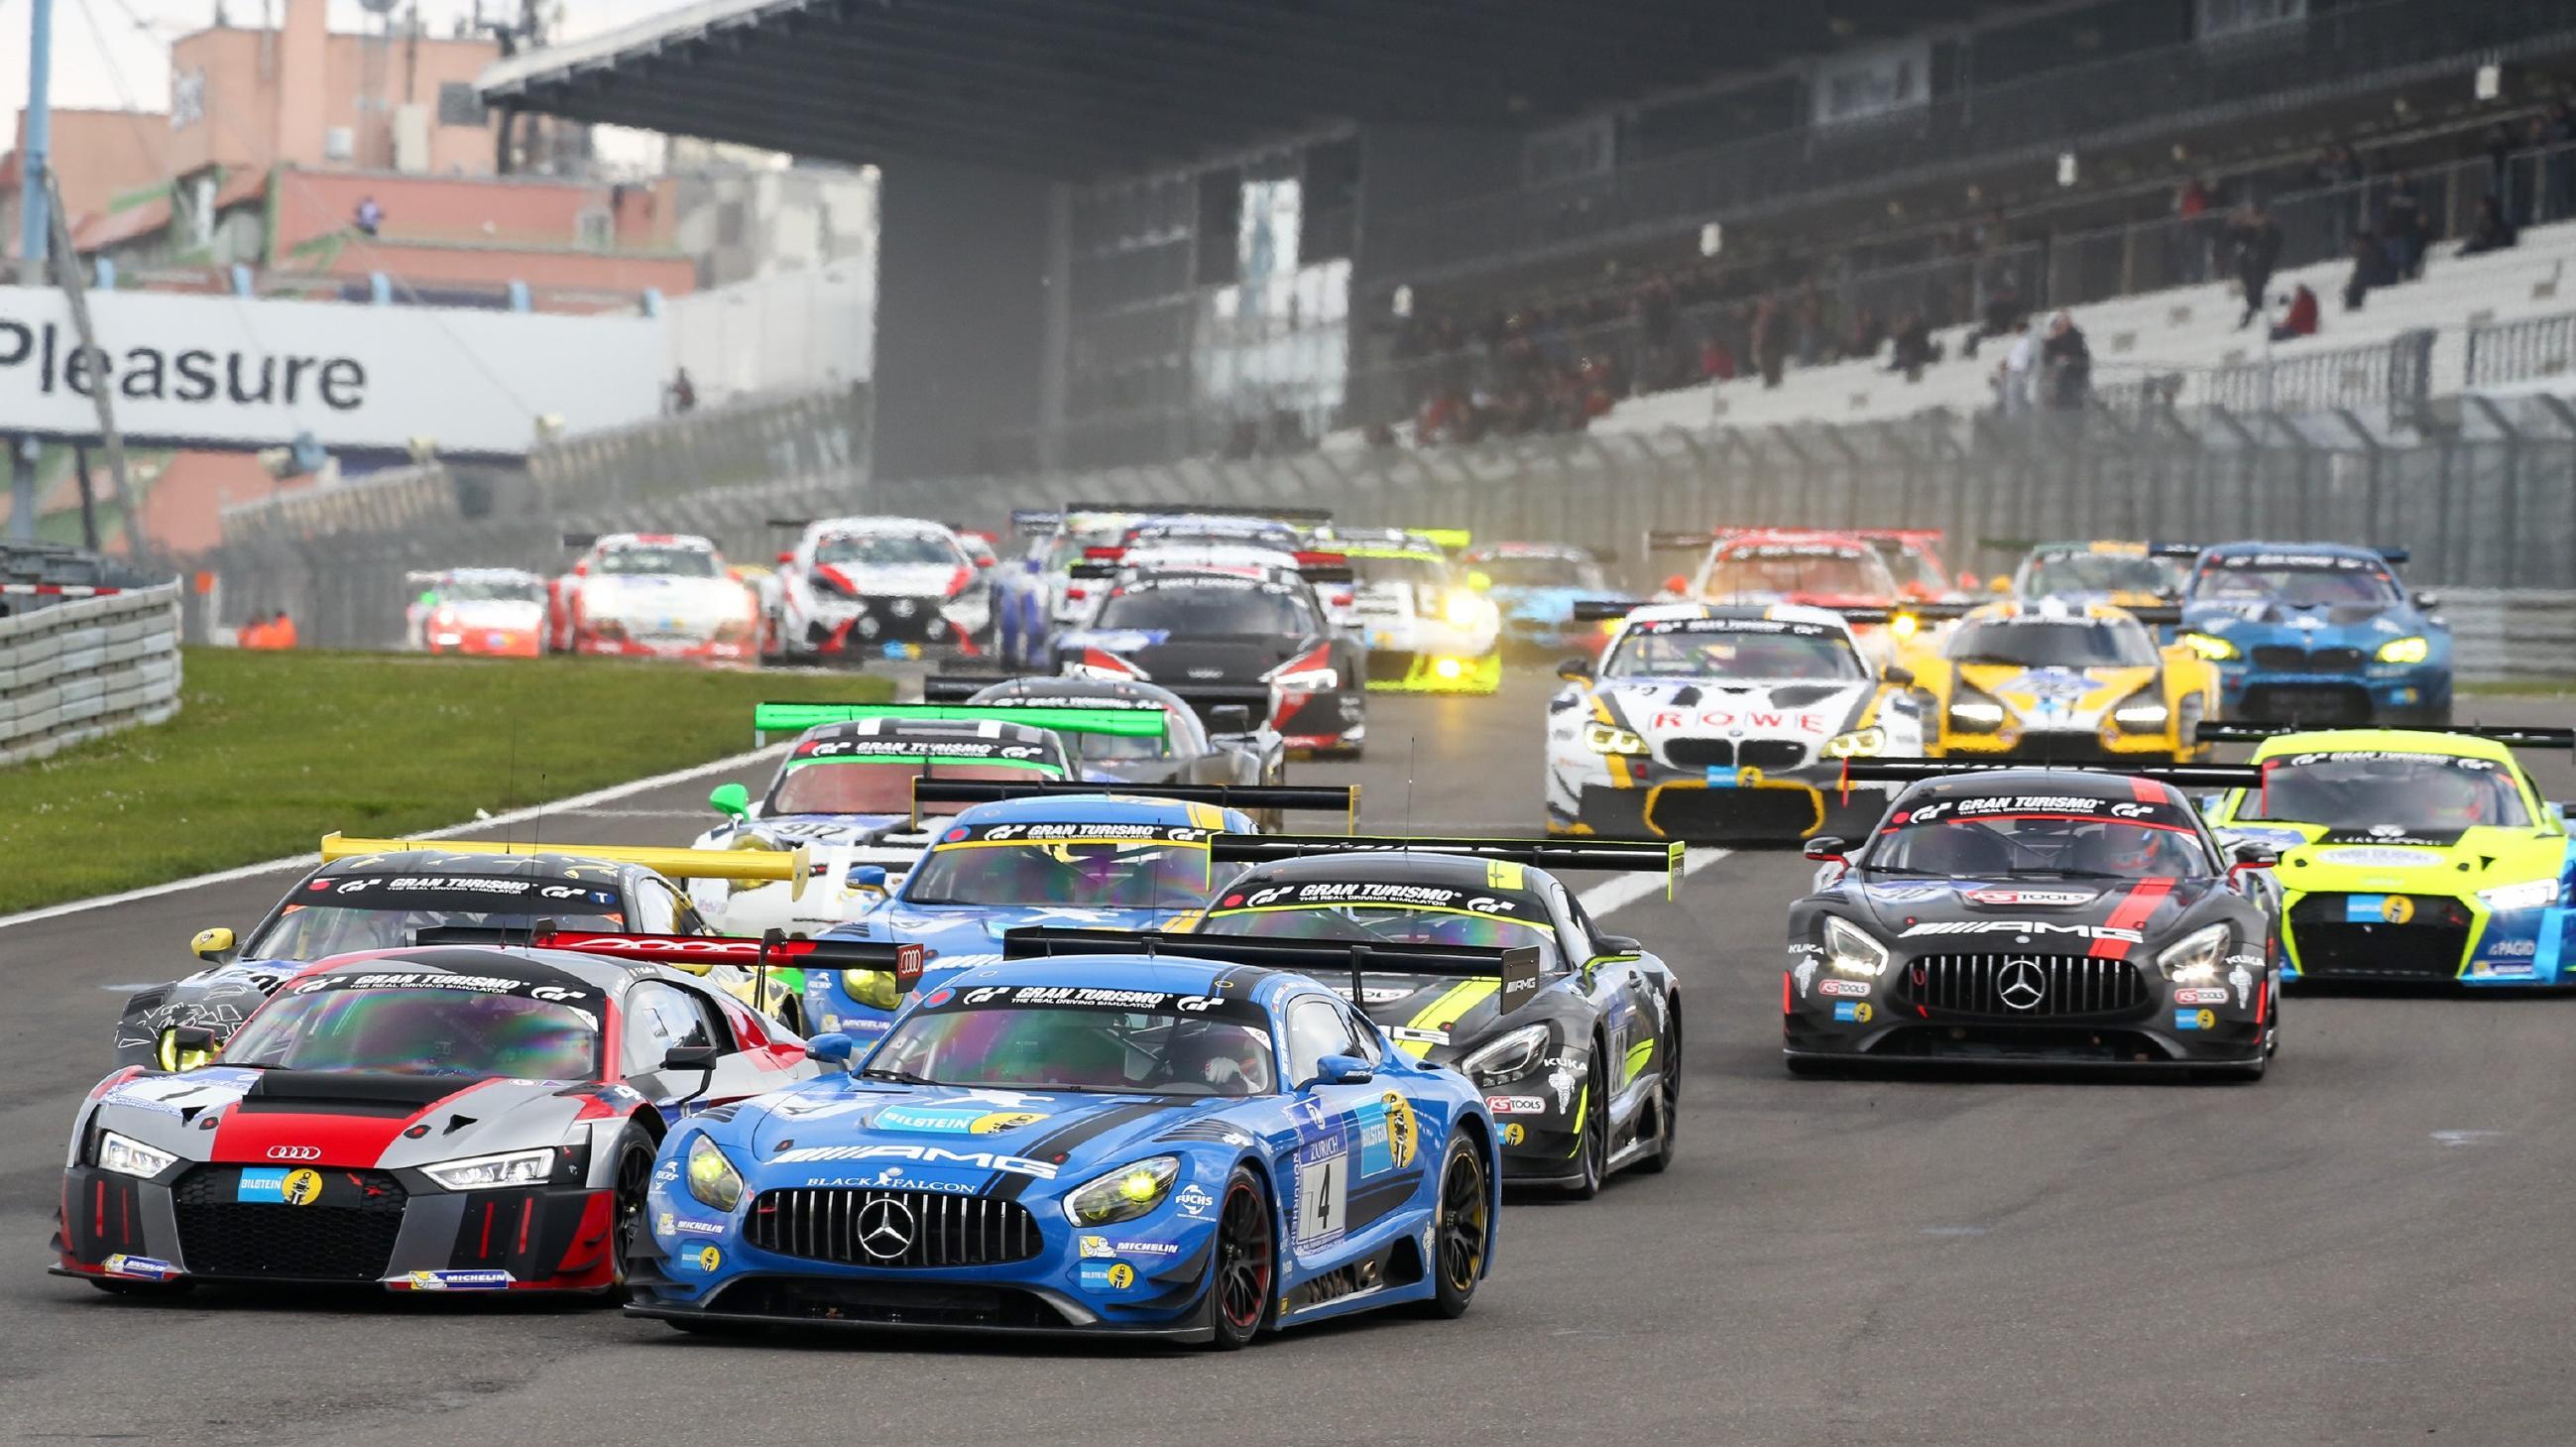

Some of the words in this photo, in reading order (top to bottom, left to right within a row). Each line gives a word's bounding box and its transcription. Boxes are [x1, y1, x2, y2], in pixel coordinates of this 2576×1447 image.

[0, 321, 366, 410] Pleasure
[1655, 712, 1825, 734] ROWE
[857, 742, 907, 752] GRAN
[1957, 796, 2013, 810] GRAN
[2015, 796, 2098, 809] TURISMO
[1027, 824, 1077, 835] GRAN
[1079, 825, 1155, 836] TURISMO
[388, 878, 445, 889] GRAN
[445, 878, 531, 891] TURISMO
[1299, 884, 1360, 897] GRAN
[1360, 884, 1455, 902] TURISMO
[1389, 896, 1448, 907] SIMULATOR
[354, 974, 421, 985] GRAN
[421, 974, 522, 990] TURISMO
[446, 983, 509, 994] SIMULATOR
[1514, 977, 1537, 991] AMG
[1014, 987, 1075, 999] GRAN
[1075, 988, 1166, 1005] TURISMO
[1544, 1057, 1588, 1072] KUKA
[1488, 1097, 1511, 1110] KS
[1511, 1098, 1542, 1110] TOOLS
[883, 1111, 970, 1130] BILSTEIN
[1310, 1135, 1339, 1161] ZURICH
[854, 1145, 1061, 1180] AMG
[240, 1178, 283, 1190] BILSTEIN
[806, 1176, 873, 1187] BLACK
[891, 1177, 977, 1193] FALCON
[1175, 1195, 1214, 1206] FUCHS
[1317, 1163, 1331, 1230] 4
[677, 1220, 726, 1234] MICHELIN
[1116, 1241, 1179, 1254] MICHELIN
[445, 1273, 507, 1282] MICHELIN
